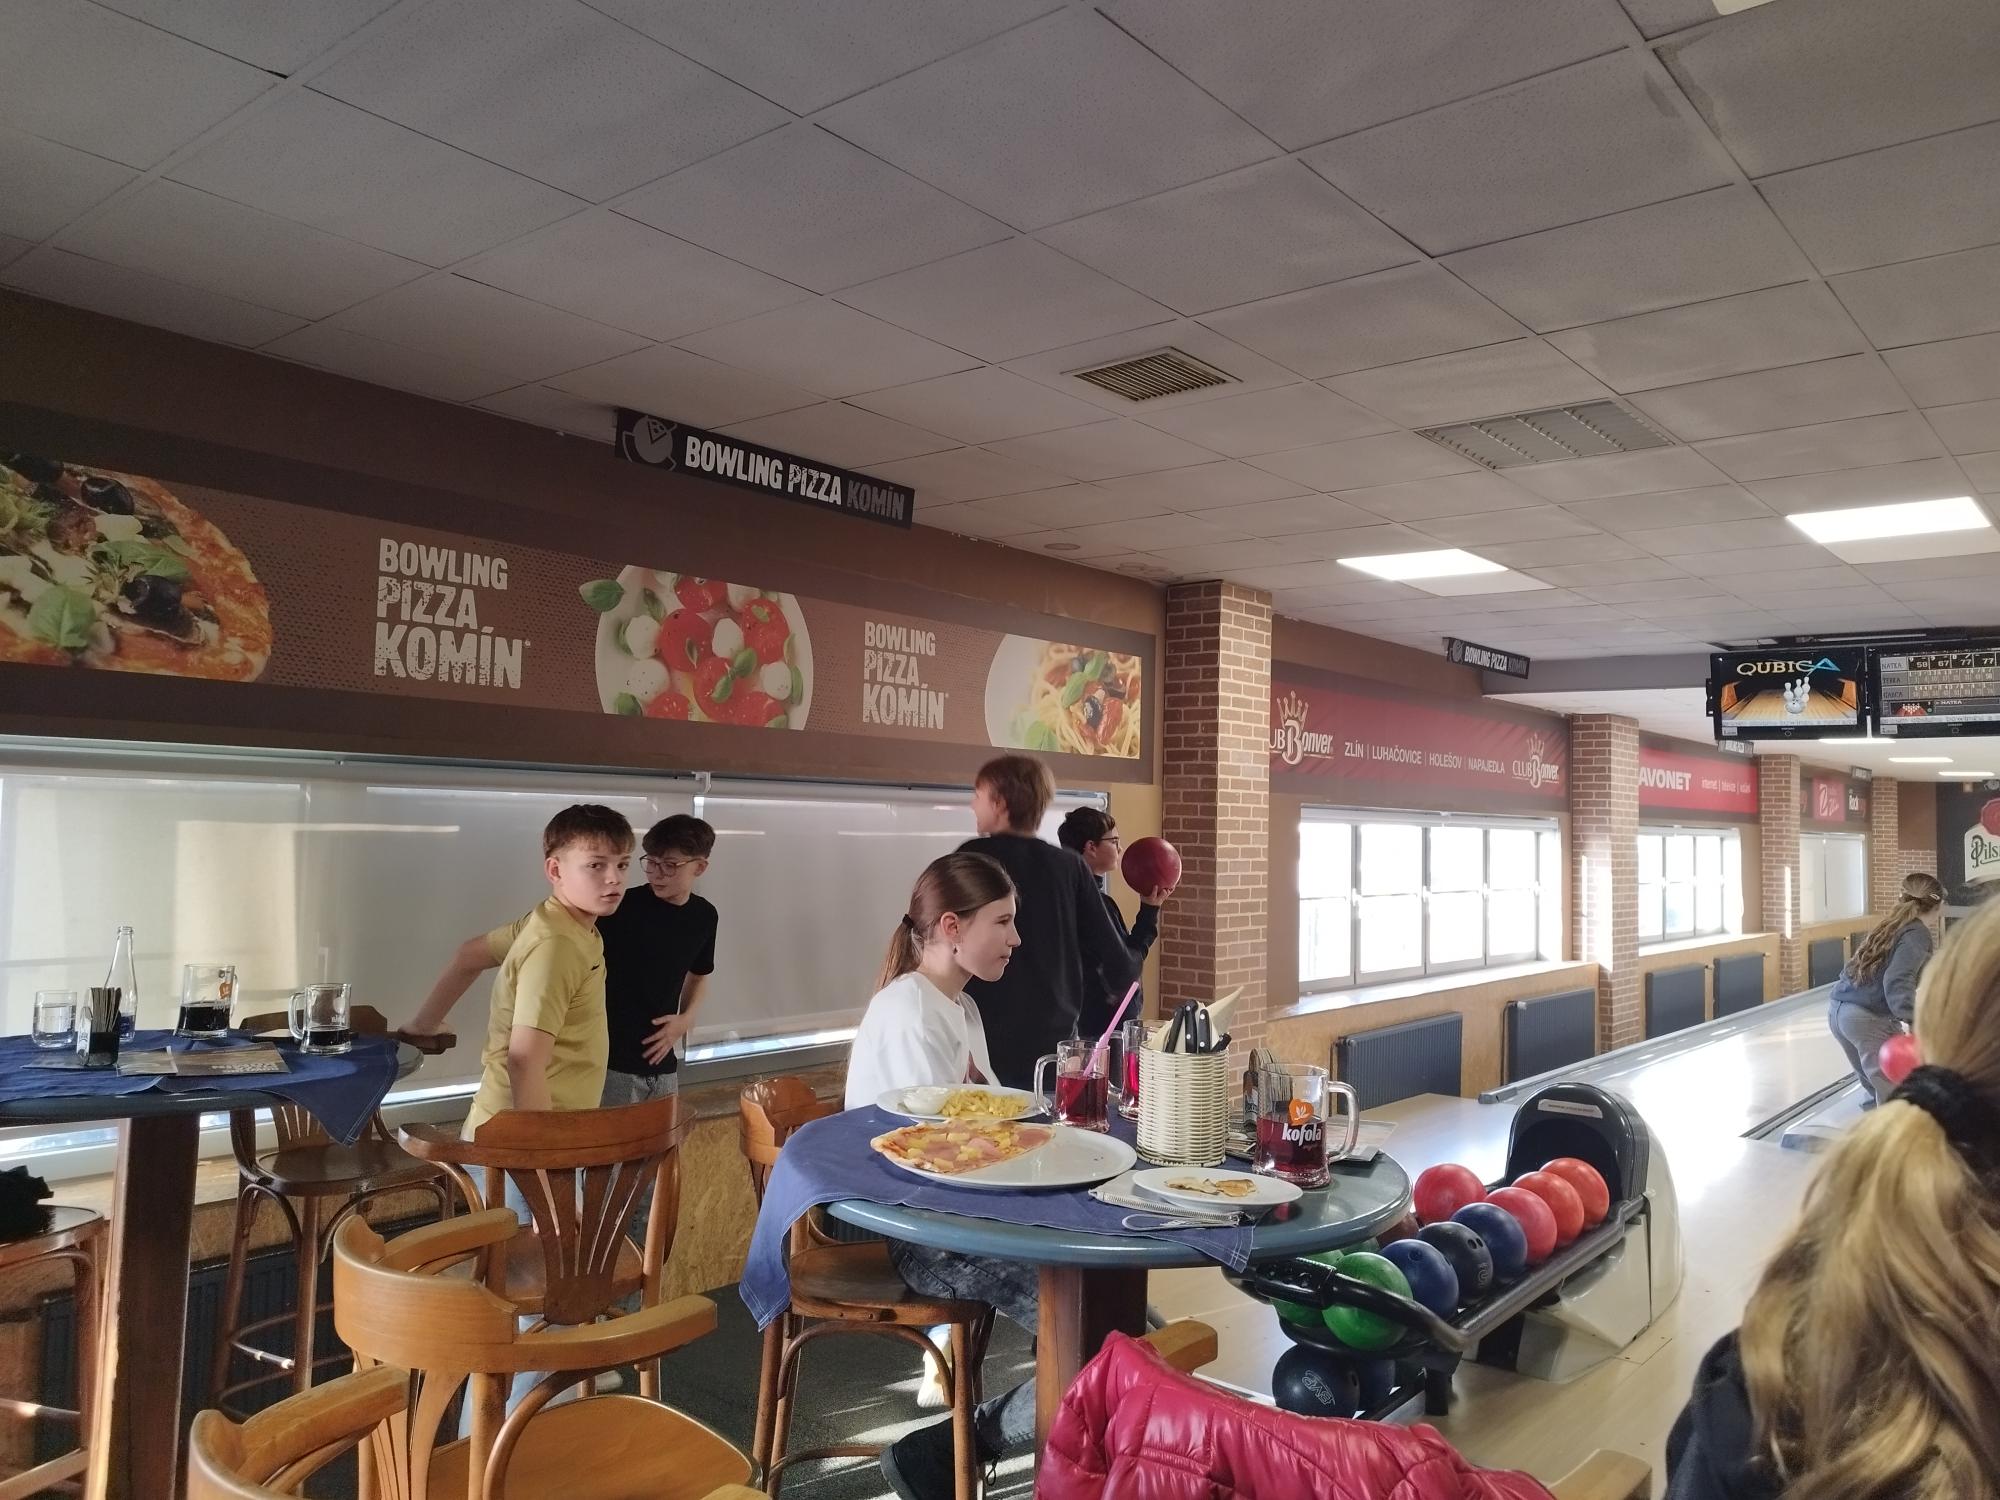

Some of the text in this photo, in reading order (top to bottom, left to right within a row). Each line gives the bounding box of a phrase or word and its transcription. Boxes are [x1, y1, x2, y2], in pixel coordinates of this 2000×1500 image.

[685, 436, 904, 521] BOWLING PIZZA KOMÍN
[379, 538, 508, 590] BOWLING
[377, 576, 478, 629] PIZZA
[374, 621, 523, 689] KOMÍN
[865, 621, 936, 656] BOWLING
[864, 649, 919, 686] PIZZA
[1465, 646, 1491, 667] BOWLING
[1490, 652, 1508, 671] PIZZA
[1736, 658, 1841, 676] QUBICA
[863, 683, 945, 729] KOMÍN
[1269, 719, 1333, 765] UB Bonver
[1344, 740, 1506, 774] ZLÍN LUHAČOVICE HOLEŠOV NAPAJEDLA
[1512, 760, 1532, 777] CLUB
[1639, 766, 1693, 791] AVONET
[1971, 834, 2000, 868] Pils
[1282, 1122, 1322, 1147] kofola
